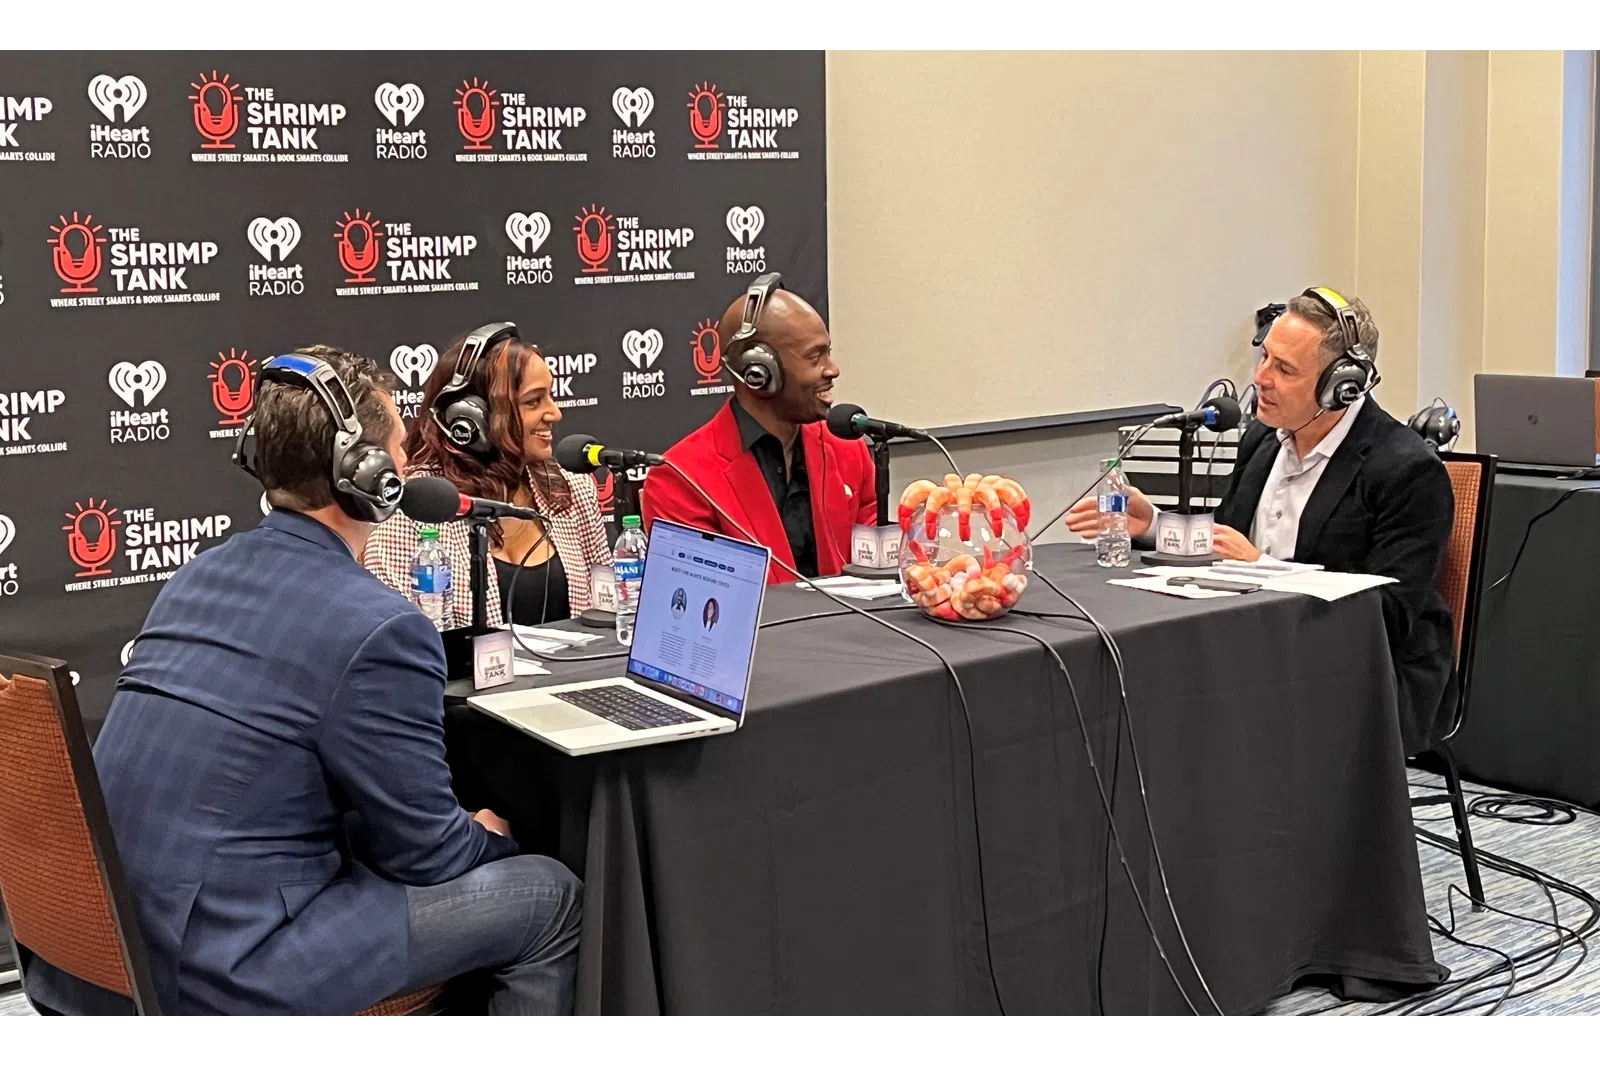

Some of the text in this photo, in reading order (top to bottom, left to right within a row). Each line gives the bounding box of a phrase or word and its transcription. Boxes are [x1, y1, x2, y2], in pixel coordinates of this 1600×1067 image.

[245, 88, 274, 101] THE
[501, 93, 525, 105] THE
[727, 96, 747, 107] THE
[0, 97, 52, 120] IMP
[248, 102, 346, 125] SHRIMP
[503, 107, 586, 127] SHRIMP
[728, 108, 798, 127] SHRIMP
[90, 124, 149, 142] iHeart
[247, 127, 318, 149] TANK
[377, 128, 426, 144] iHeart
[502, 130, 562, 149] TANK
[613, 129, 655, 143] iHeart
[728, 130, 777, 148] TANK
[25, 152, 55, 161] COLLIDE
[91, 143, 151, 158] RADIO
[191, 154, 217, 162] WHERE
[217, 154, 241, 162] STREET
[243, 154, 269, 162] SMARTS
[277, 154, 295, 162] BOOK
[296, 154, 322, 162] SMARTS
[322, 154, 349, 162] COLLIDE
[377, 145, 427, 159] RADIO
[613, 145, 656, 157] RADIO
[385, 223, 411, 236] THE
[616, 217, 639, 229] THE
[108, 228, 140, 241] THE
[618, 228, 694, 250] SHRIMP
[111, 242, 217, 266] SHRIMP
[387, 236, 477, 258] SHRIMP
[727, 246, 765, 260] iHeart
[507, 255, 551, 270] iHeart
[618, 250, 672, 271] TANK
[727, 260, 765, 273] RADIO
[249, 264, 302, 280] iHeart
[387, 259, 451, 281] TANK
[507, 270, 552, 284] RADIO
[111, 267, 187, 291] TANK
[250, 280, 304, 295] RADIO
[359, 287, 381, 295] STREET
[382, 286, 407, 294] SMARTS
[431, 283, 454, 292] SMARTS
[455, 282, 479, 290] COLLIDE
[50, 293, 220, 307] WHERE STREET SMARTS & BOOK SMARTS COLLIDE
[545, 353, 597, 376] RIMP
[623, 370, 664, 385] iHeart
[551, 377, 573, 397] NK
[623, 384, 665, 399] RADIO
[0, 390, 65, 415] RIMP
[392, 390, 424, 404] iHea
[111, 409, 168, 427] iHeart
[0, 417, 31, 441] NK
[111, 425, 169, 443] RADIO
[209, 429, 234, 438] WHERE
[5, 445, 37, 455] SMARTS
[37, 442, 68, 452] COLLIDE
[123, 508, 154, 523] THE
[126, 515, 231, 547] SHRIMP
[126, 542, 199, 571] TANK
